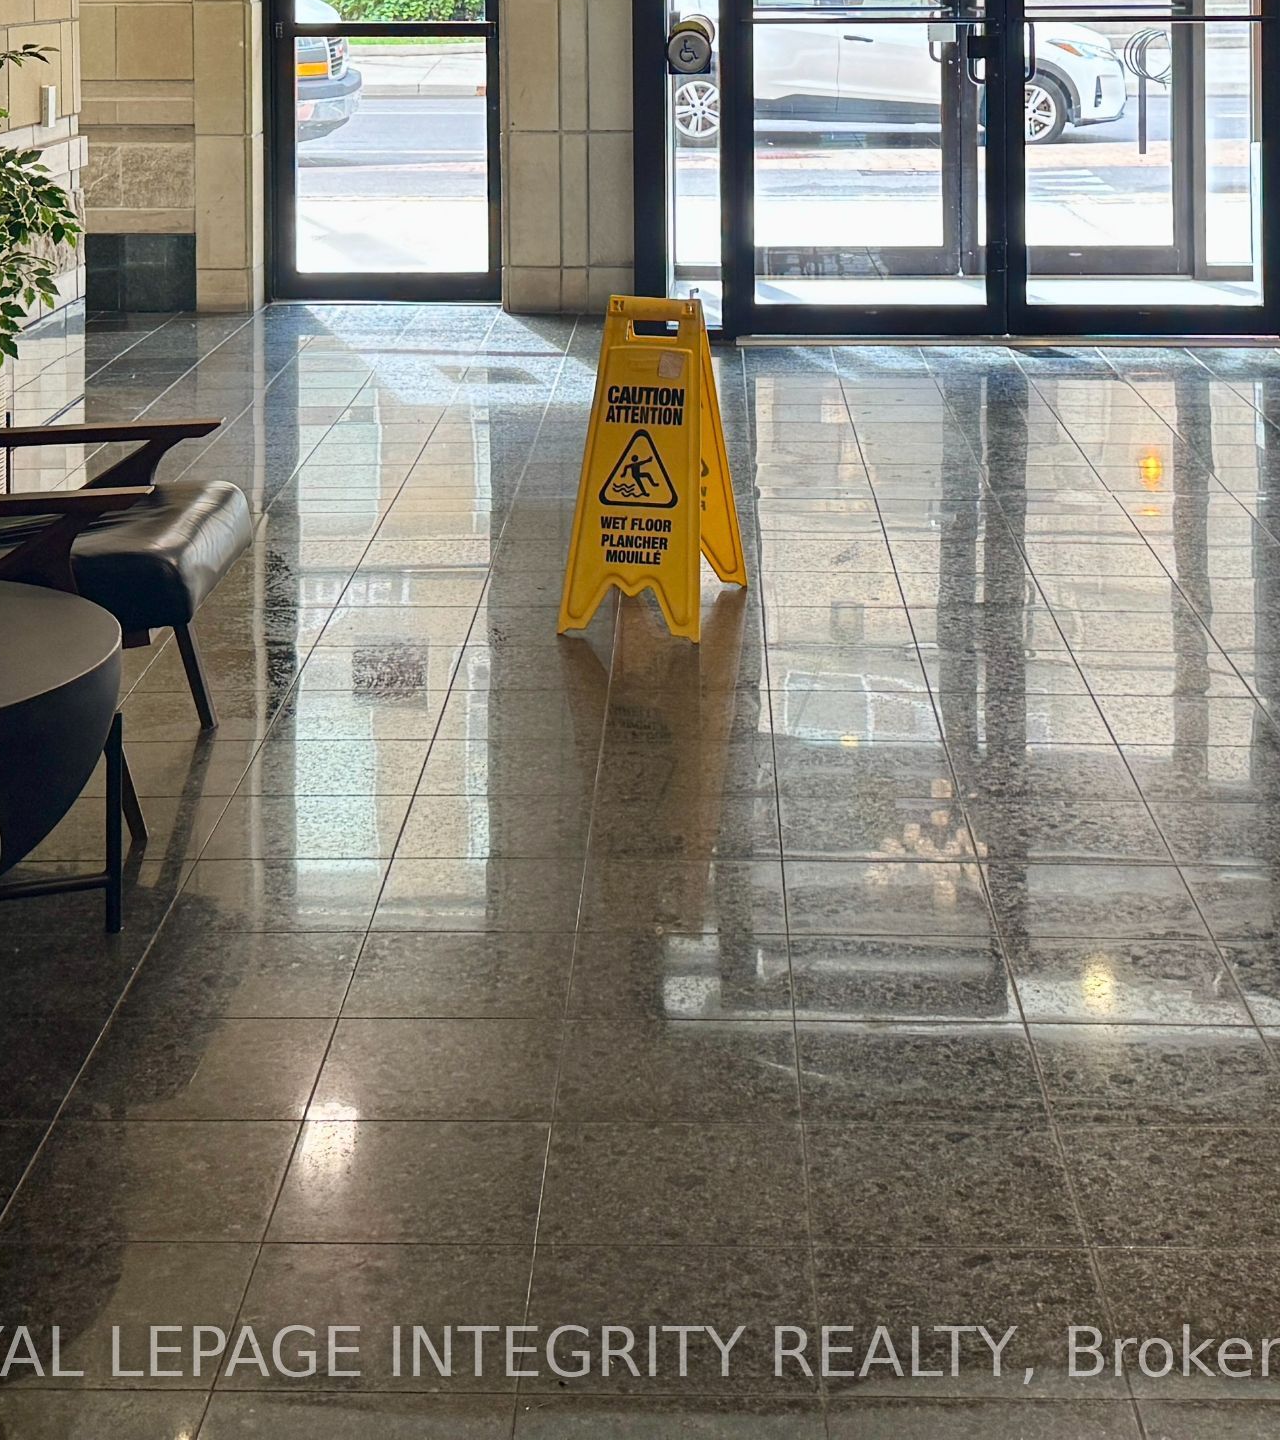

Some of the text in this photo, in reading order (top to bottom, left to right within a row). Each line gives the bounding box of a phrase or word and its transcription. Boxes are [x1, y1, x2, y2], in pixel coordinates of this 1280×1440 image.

[607, 385, 685, 407] CAUTION
[605, 405, 683, 426] ATTENTION
[600, 515, 672, 533] WET FLOOR
[600, 533, 668, 551] PLANCHER
[605, 548, 662, 566] MOUILLÉ
